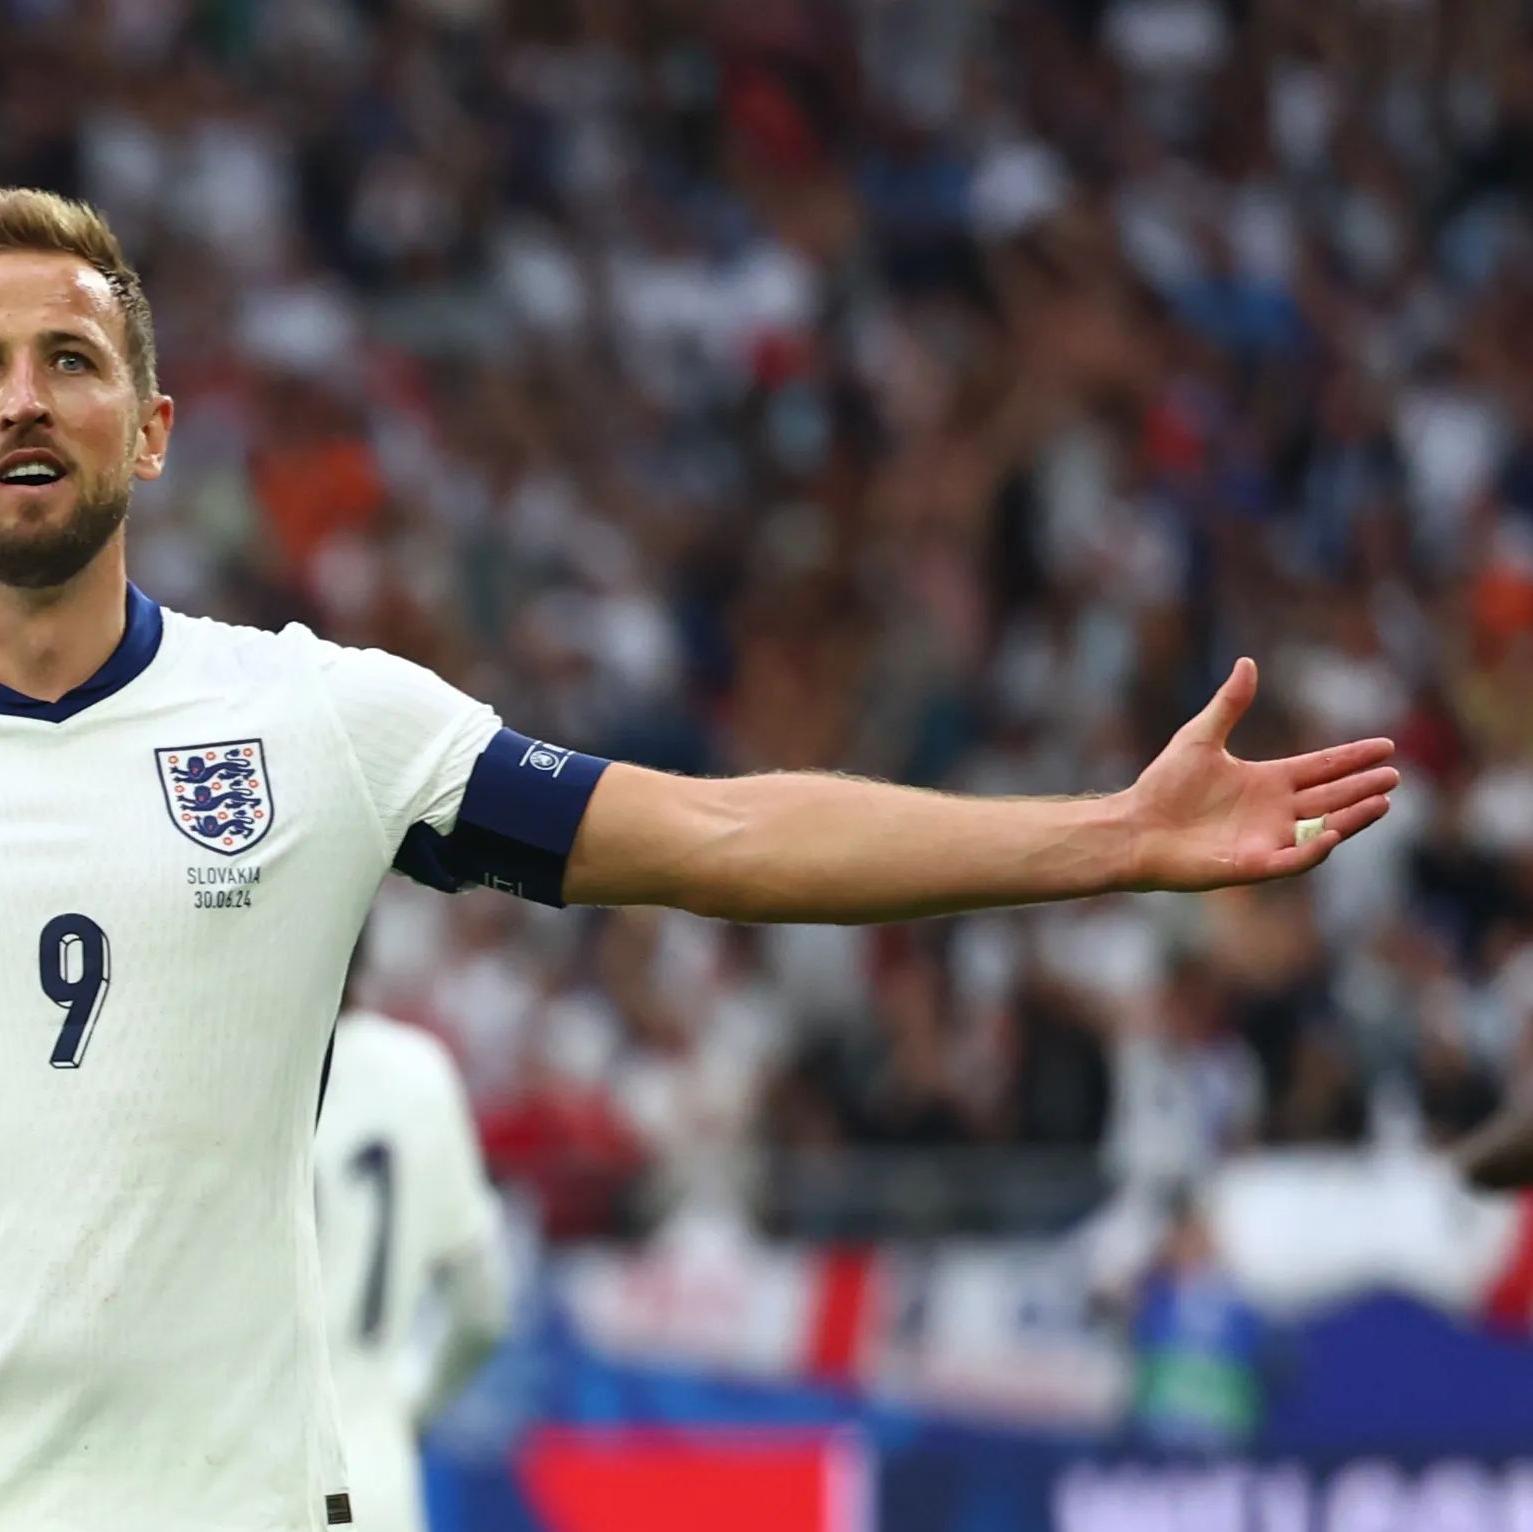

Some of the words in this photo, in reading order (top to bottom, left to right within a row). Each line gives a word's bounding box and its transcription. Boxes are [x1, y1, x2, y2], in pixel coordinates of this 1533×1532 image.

[187, 866, 261, 884] SLOVAKIA
[194, 889, 251, 908] 30.06.24
[39, 912, 111, 1068] 9
